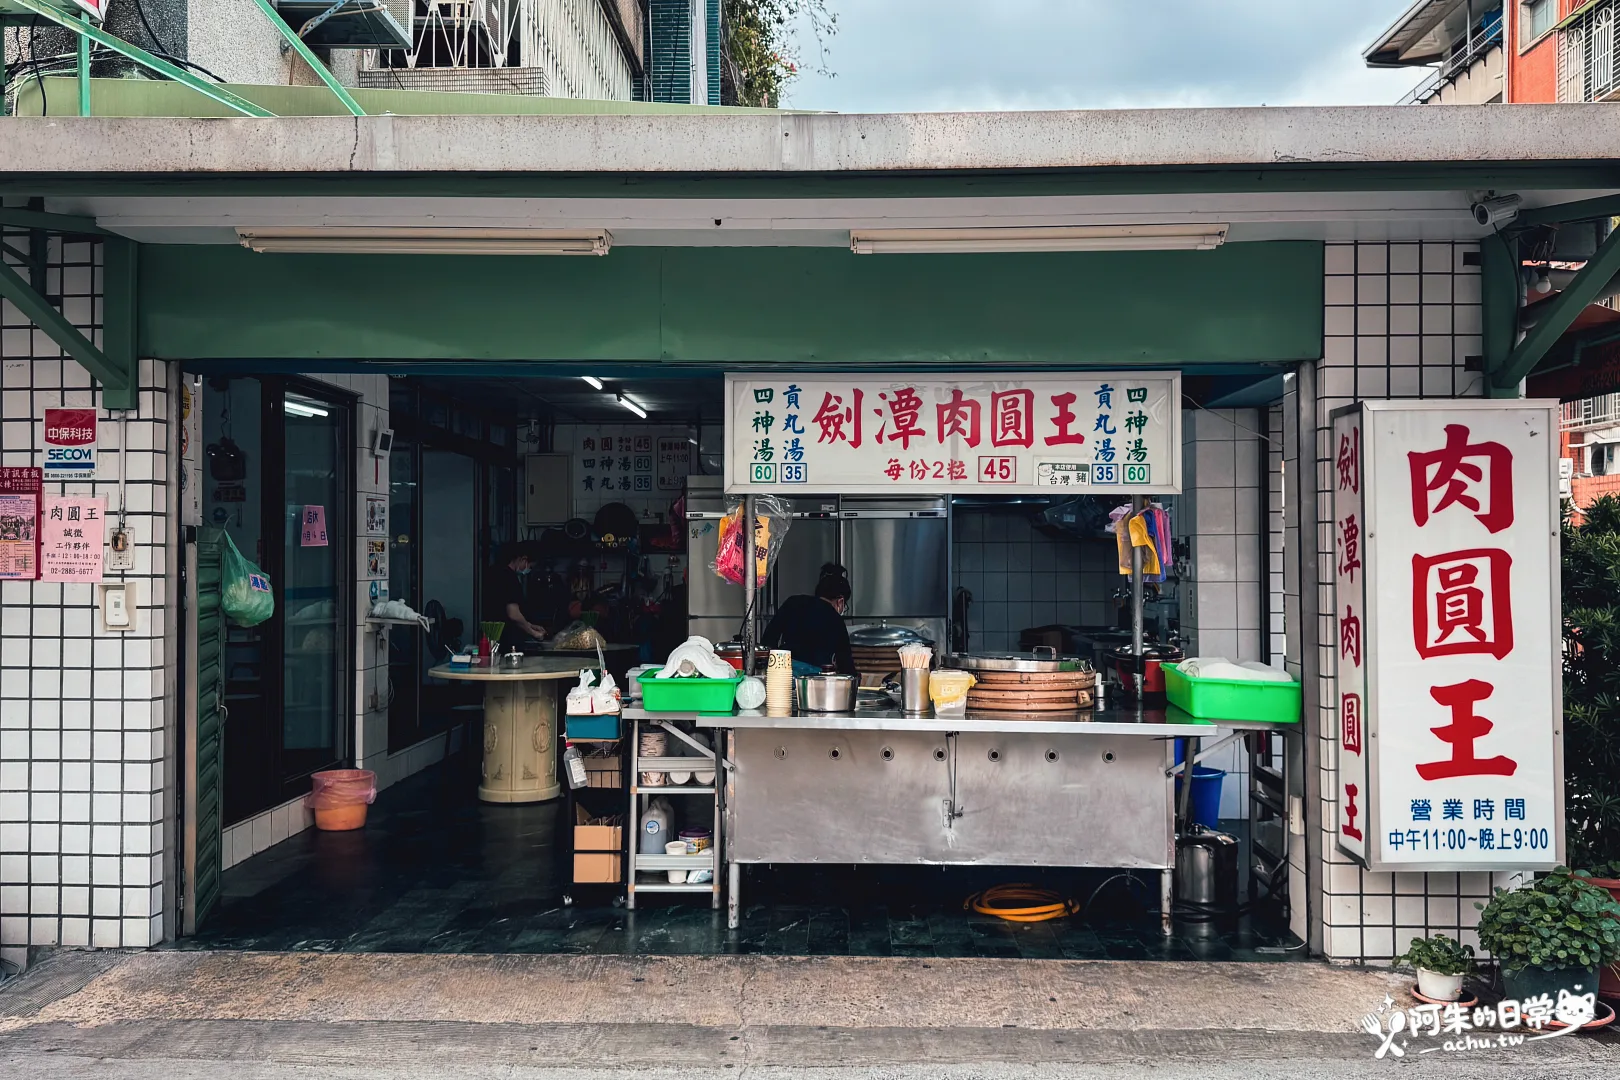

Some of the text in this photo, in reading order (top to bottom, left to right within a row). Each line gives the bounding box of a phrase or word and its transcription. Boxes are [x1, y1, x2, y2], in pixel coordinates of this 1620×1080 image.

[752, 387, 776, 462] 四神湯
[782, 384, 805, 462] 貢丸湯
[812, 387, 1085, 450] 劍潭肉圓王
[1093, 384, 1116, 462] 貢丸湯
[1124, 387, 1148, 462] 四神湯
[47, 426, 93, 441] 中保科技
[583, 436, 650, 452] 肉圓 45
[48, 448, 92, 460] SECOM
[583, 456, 650, 471] 四神湯 60
[884, 458, 1011, 481] 每份2粒 45
[754, 465, 773, 481] 60
[785, 465, 802, 481] 35
[1096, 465, 1113, 481] 35
[1127, 465, 1146, 481] 60
[582, 475, 650, 491] 貢丸湯 35
[50, 505, 100, 522] 肉圓王
[63, 528, 83, 538] 誠徵
[55, 542, 90, 551] 工作夥伴
[1407, 423, 1518, 781] 肉圓王
[1336, 425, 1362, 843] 劍潭肉圓王
[1410, 798, 1527, 821] 營業時間
[1388, 827, 1549, 852] 中午11:00~晚上9:00
